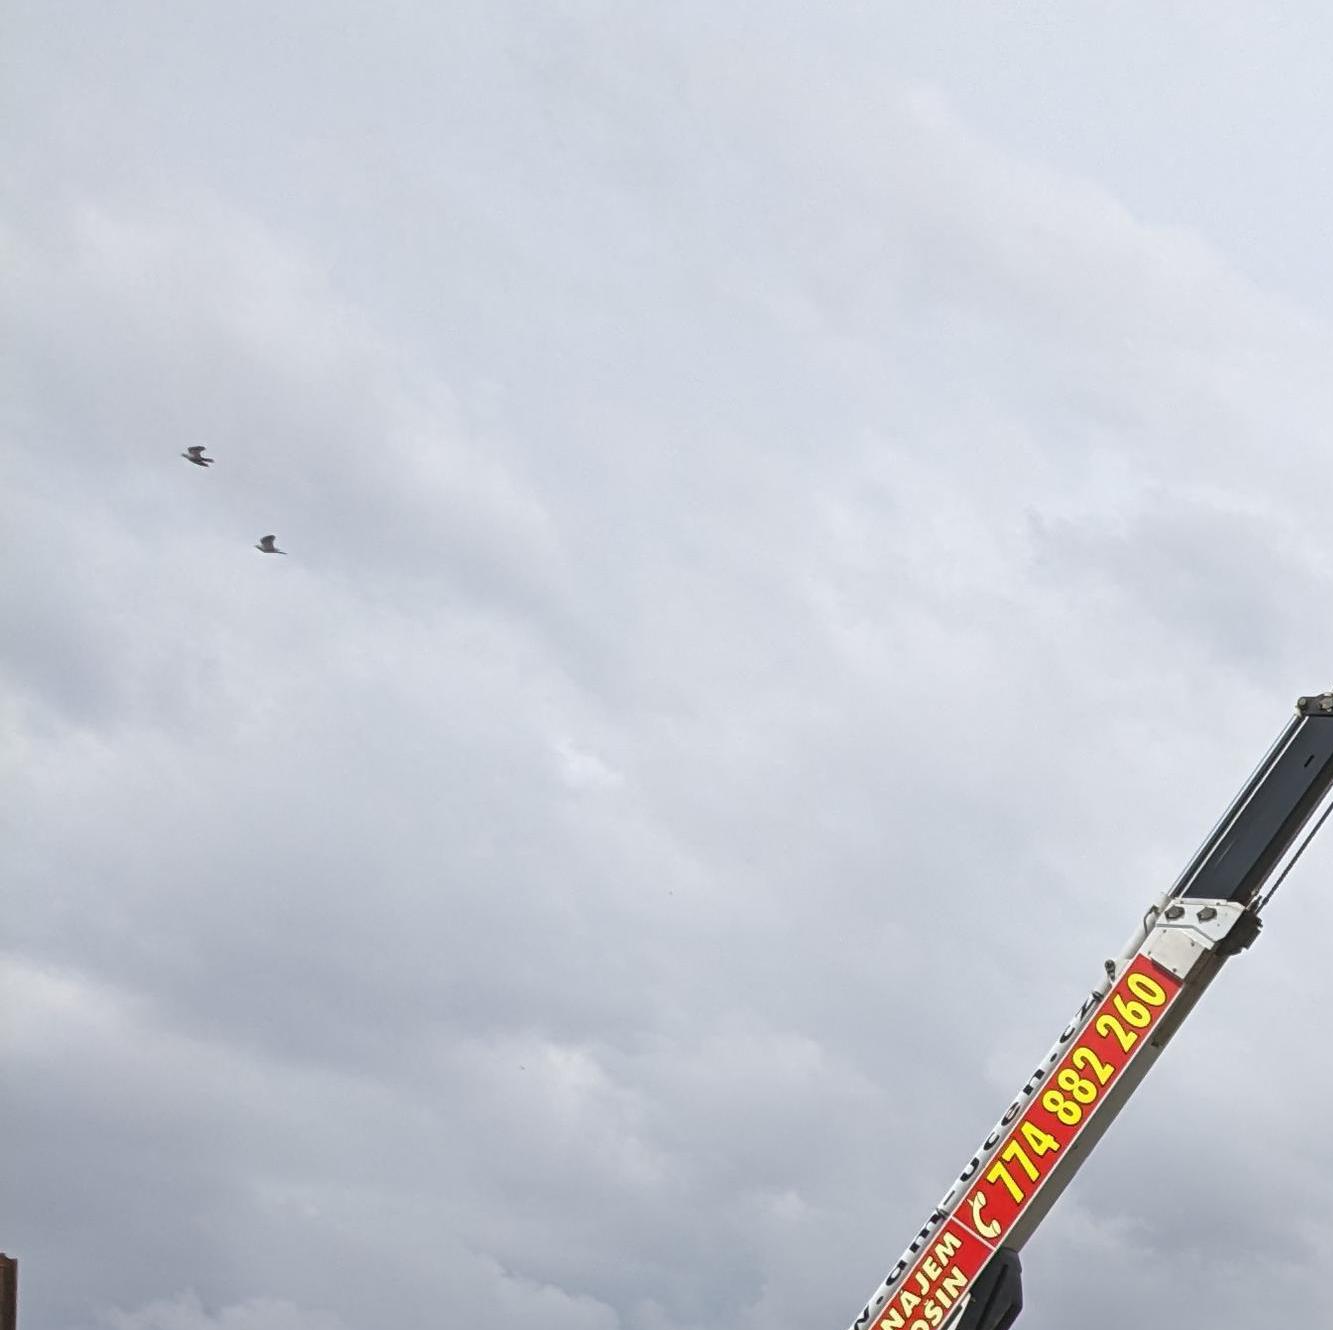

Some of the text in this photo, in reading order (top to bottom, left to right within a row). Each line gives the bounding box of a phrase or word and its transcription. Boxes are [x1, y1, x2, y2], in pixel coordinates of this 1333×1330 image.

[986, 972, 1167, 1204] 774 882 260
